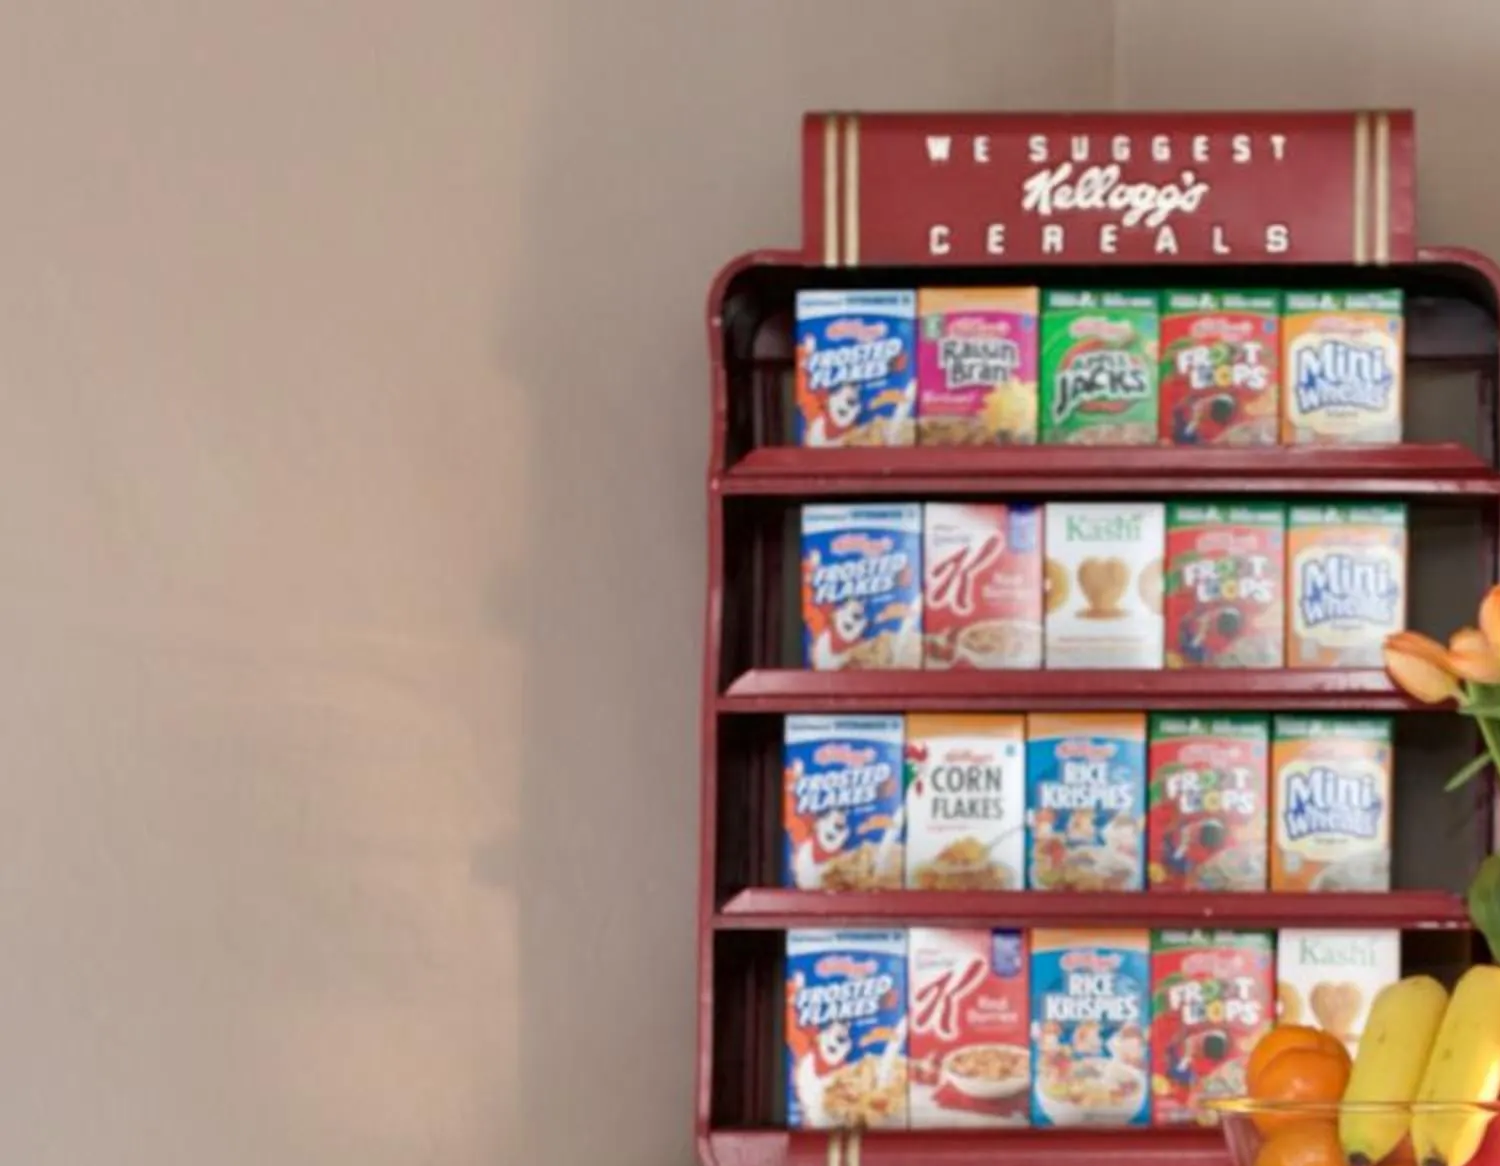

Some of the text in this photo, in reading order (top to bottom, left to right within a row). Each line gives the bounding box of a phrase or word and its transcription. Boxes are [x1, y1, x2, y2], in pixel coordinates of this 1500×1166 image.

[926, 134, 1287, 162] WE SUGGEST
[1022, 162, 1210, 228] Kellogg's
[928, 224, 1290, 256] CEREALS
[949, 362, 1010, 387] Bran
[1298, 342, 1384, 386] Mini
[1053, 367, 1147, 419] JACKS
[1065, 513, 1144, 543] Kashi
[1302, 554, 1390, 599] Mini
[930, 766, 1003, 794] CORN
[1287, 767, 1376, 809] Mini
[930, 796, 1005, 821] FLAKES
